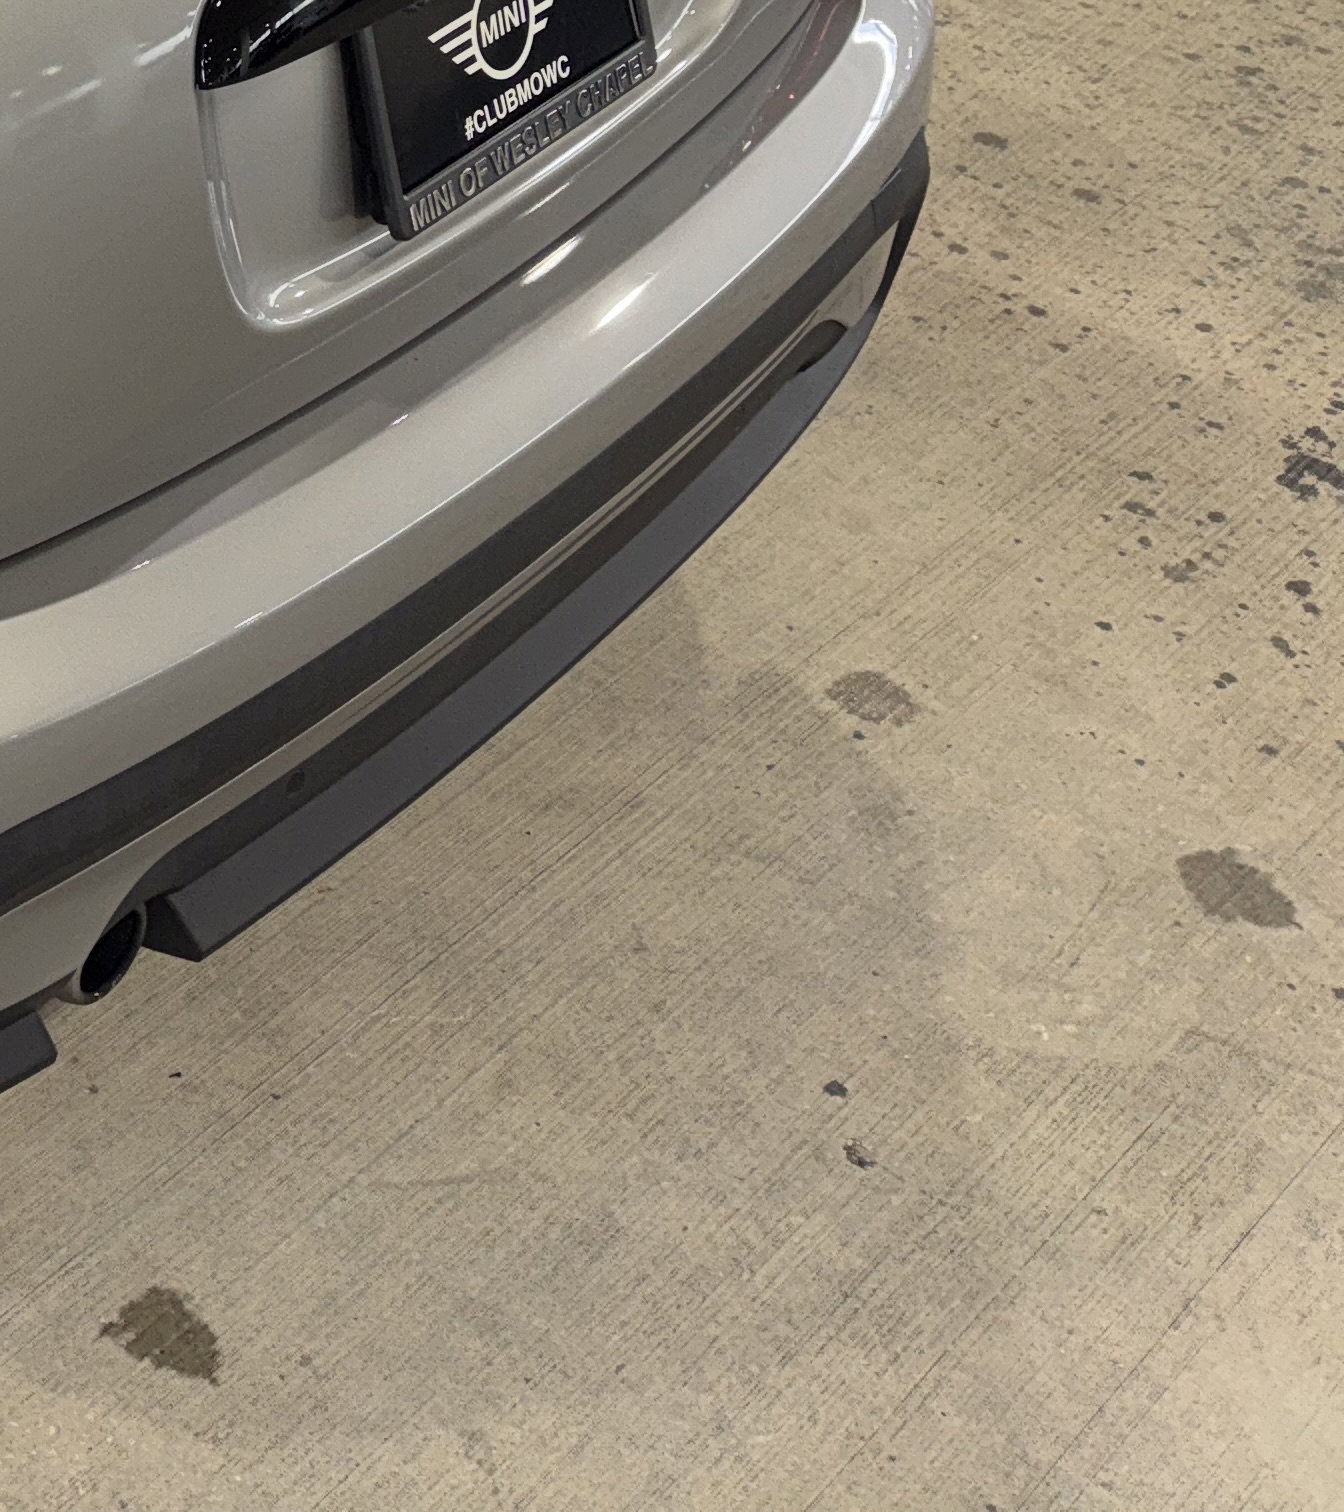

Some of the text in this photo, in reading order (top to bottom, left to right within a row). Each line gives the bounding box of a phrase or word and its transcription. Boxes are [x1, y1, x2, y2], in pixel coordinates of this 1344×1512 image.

[409, 51, 654, 232] MINI OF WESLEY CHAPEL
[464, 55, 571, 141] #CLUBMOWC
